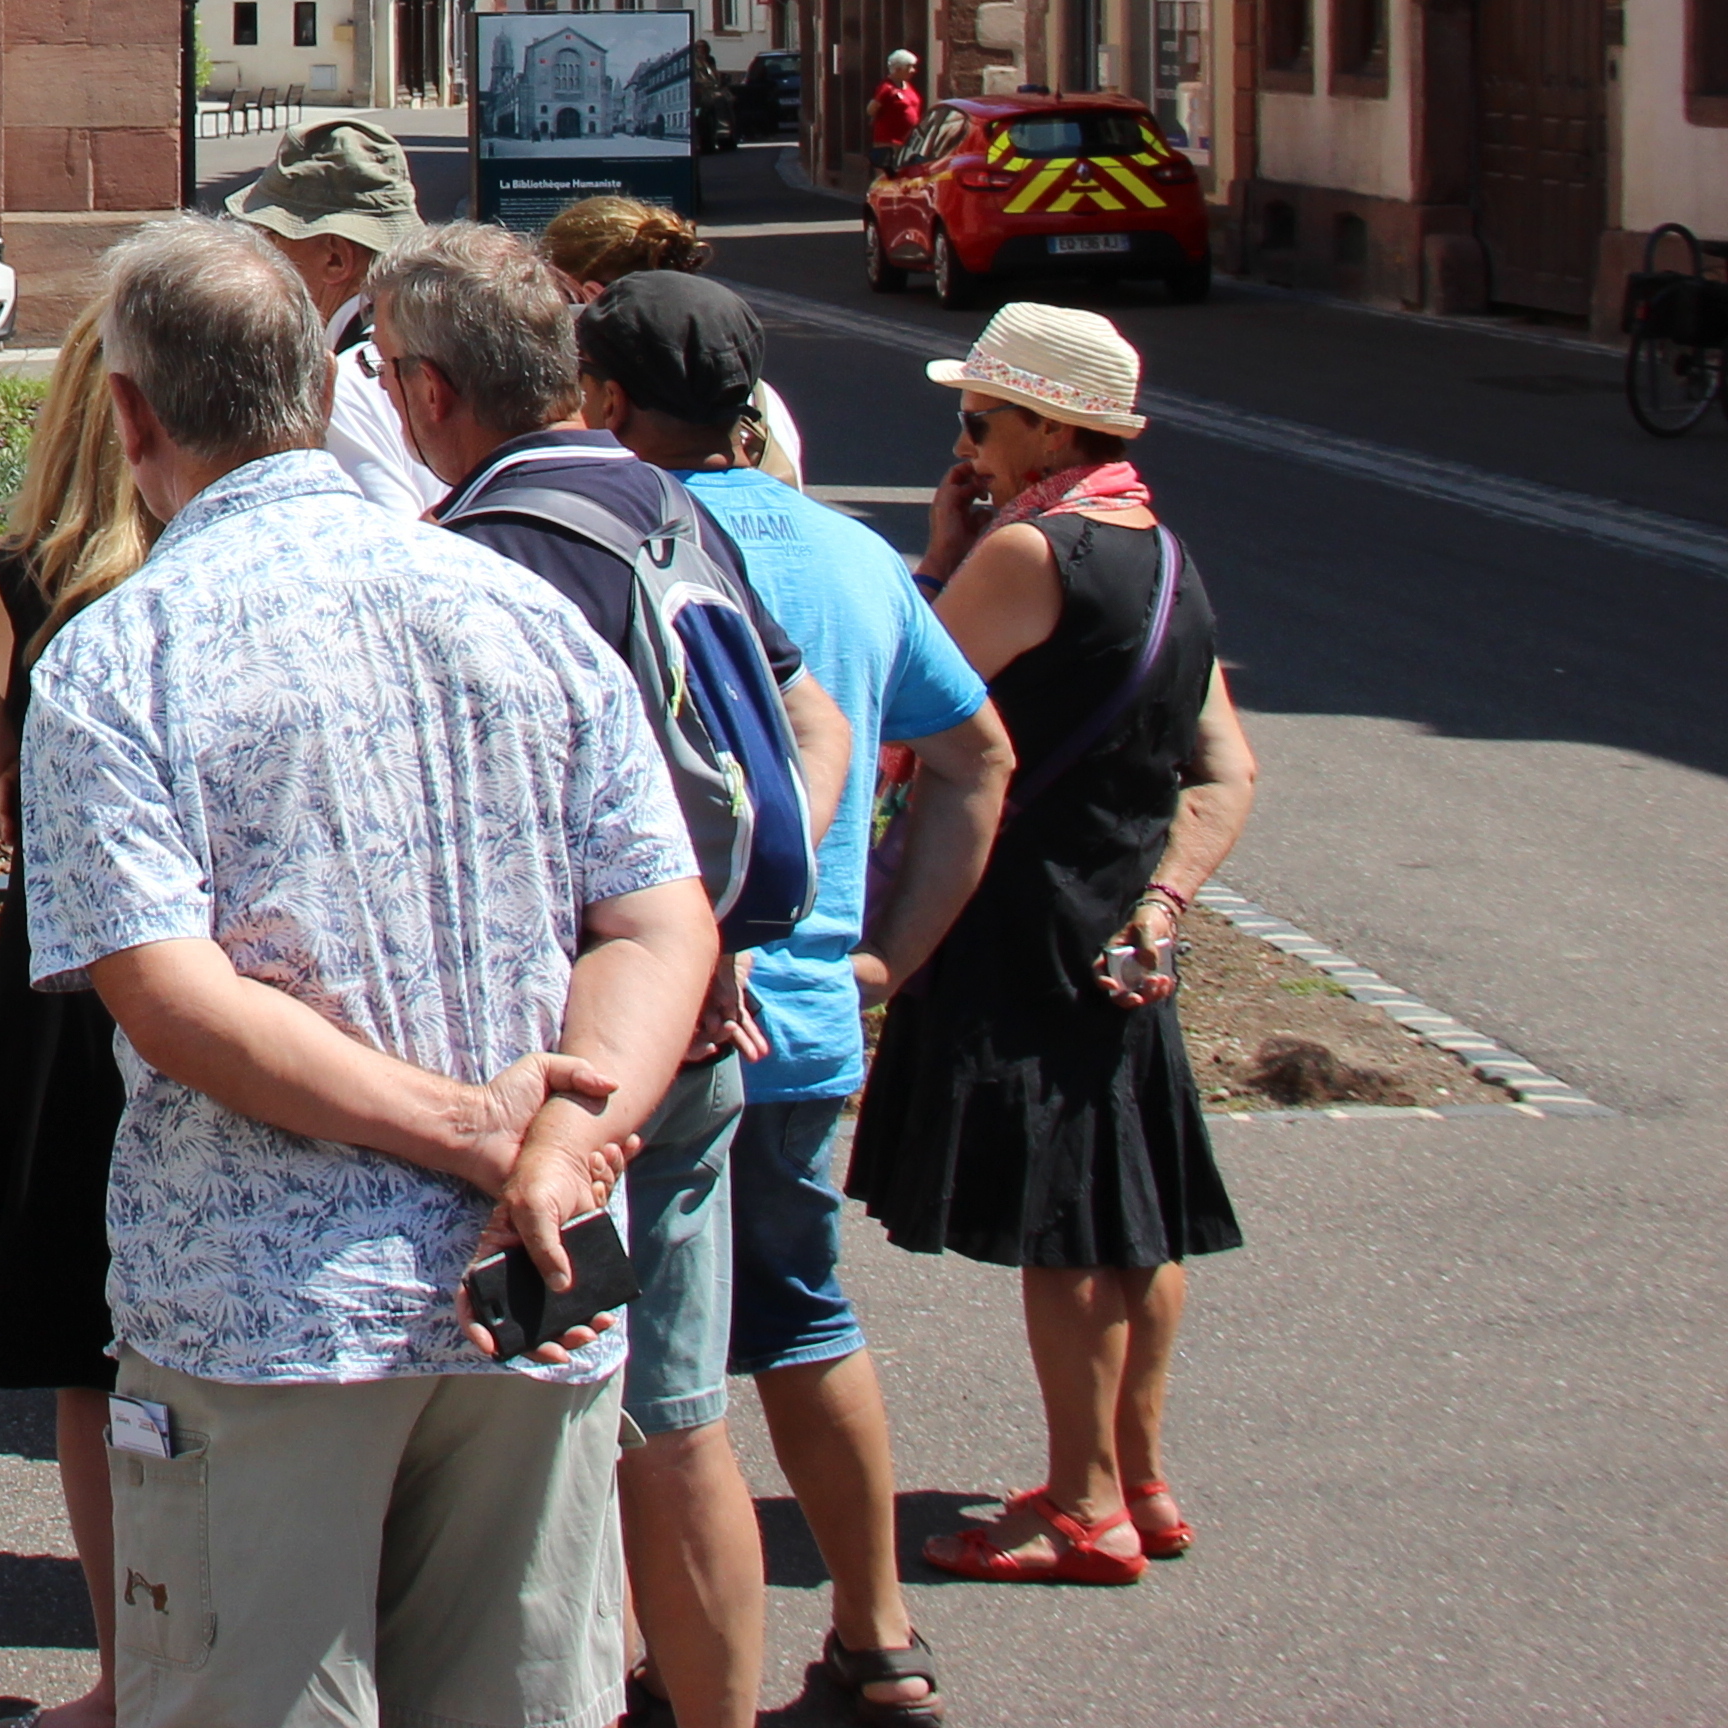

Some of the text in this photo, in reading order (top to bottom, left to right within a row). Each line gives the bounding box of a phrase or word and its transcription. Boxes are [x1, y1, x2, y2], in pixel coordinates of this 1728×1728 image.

[499, 178, 622, 191] La Bibliothèque Humaniste
[729, 513, 799, 541] MIAMI
